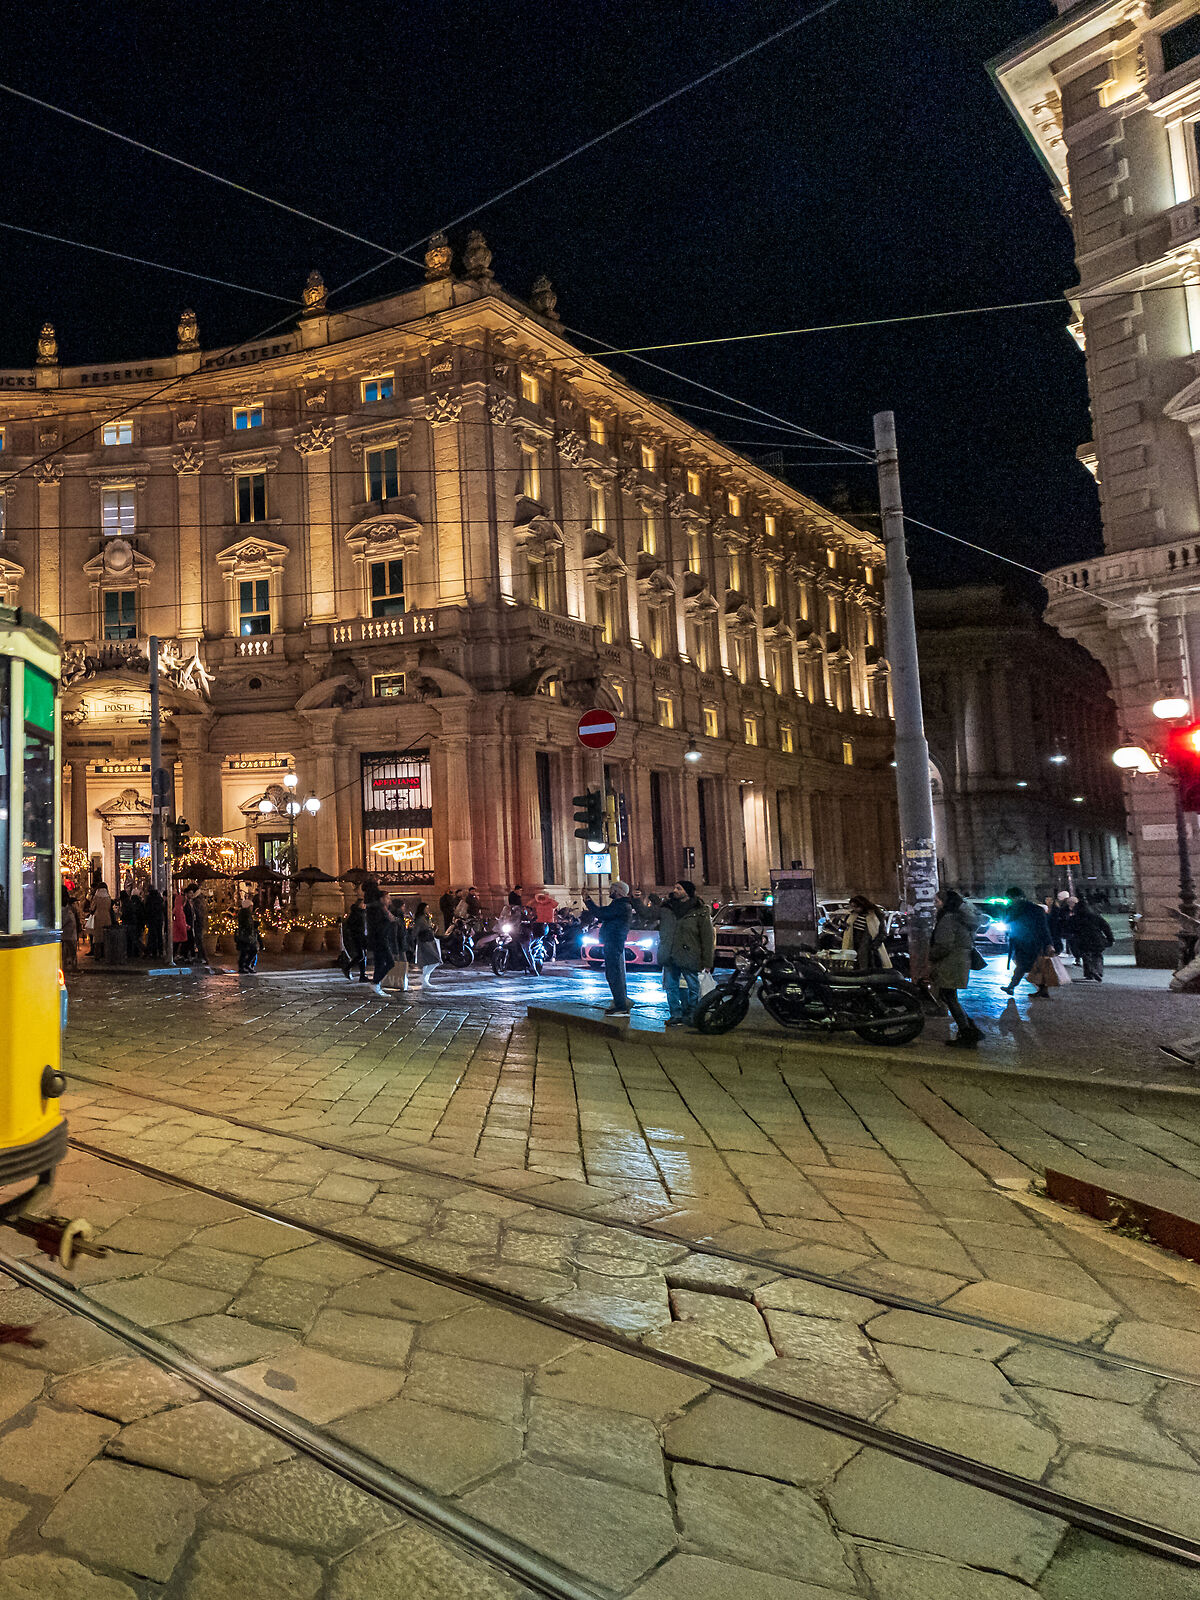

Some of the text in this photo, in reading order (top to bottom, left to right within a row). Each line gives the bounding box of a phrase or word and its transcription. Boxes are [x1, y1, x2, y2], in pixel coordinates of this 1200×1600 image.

[81, 367, 154, 384] RESERVE
[206, 342, 293, 368] ROASTERY
[104, 703, 134, 712] POSTE
[102, 765, 143, 773] RESERVE
[234, 760, 282, 769] ROASTERY
[1056, 855, 1079, 863] TAXI
